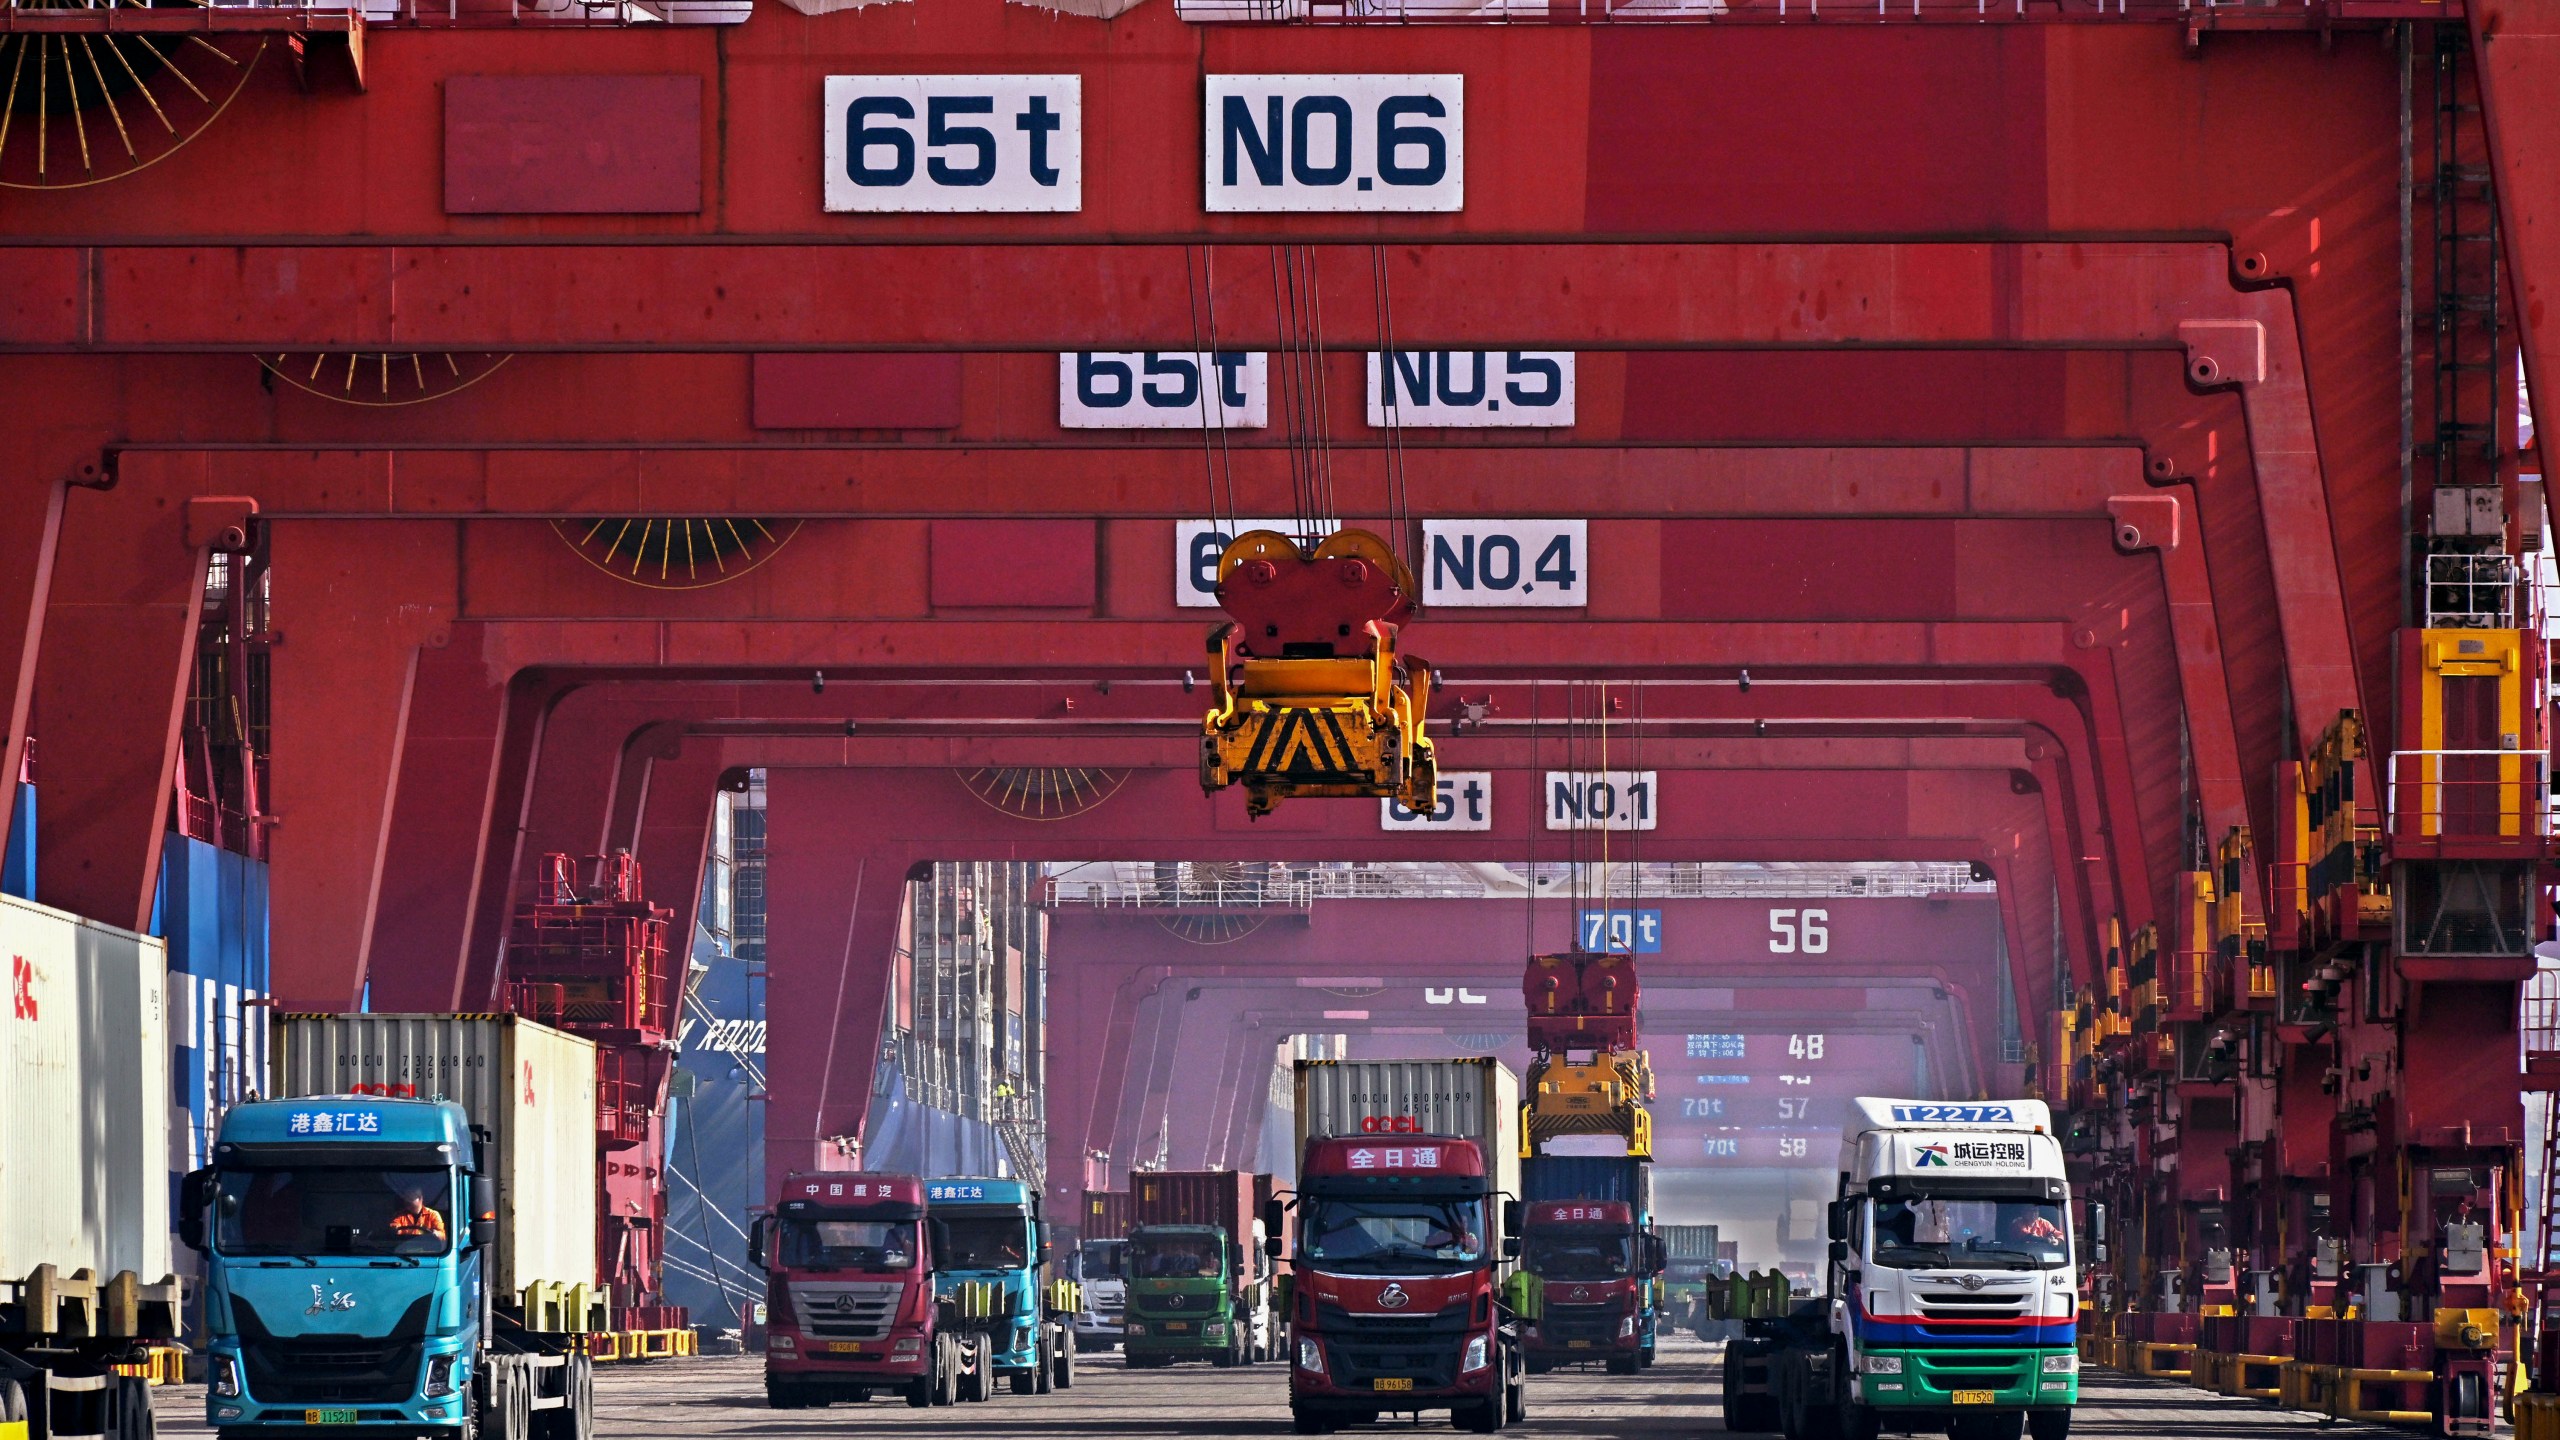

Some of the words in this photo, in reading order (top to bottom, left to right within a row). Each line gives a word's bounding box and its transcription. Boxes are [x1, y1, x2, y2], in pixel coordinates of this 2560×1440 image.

[846, 95, 1061, 186] 65t
[1222, 95, 1447, 191] NO.6
[1433, 534, 1577, 594] NO.4
[1554, 781, 1649, 821] NO.1
[1769, 908, 1829, 954] 56
[1788, 1034, 1824, 1060] 48
[1778, 1097, 1810, 1119] 57
[1894, 1106, 2010, 1122] T2272
[290, 1112, 379, 1133] 港鑫汇达
[1361, 1115, 1424, 1133] OOCL
[1350, 1147, 1438, 1169] 全日通
[1779, 1138, 1807, 1157] 58
[1954, 1142, 2025, 1160] 城运控股
[805, 1183, 892, 1197] 中国重汽
[930, 1186, 983, 1199] 港鑫汇达
[1553, 1207, 1603, 1221] 全日通
